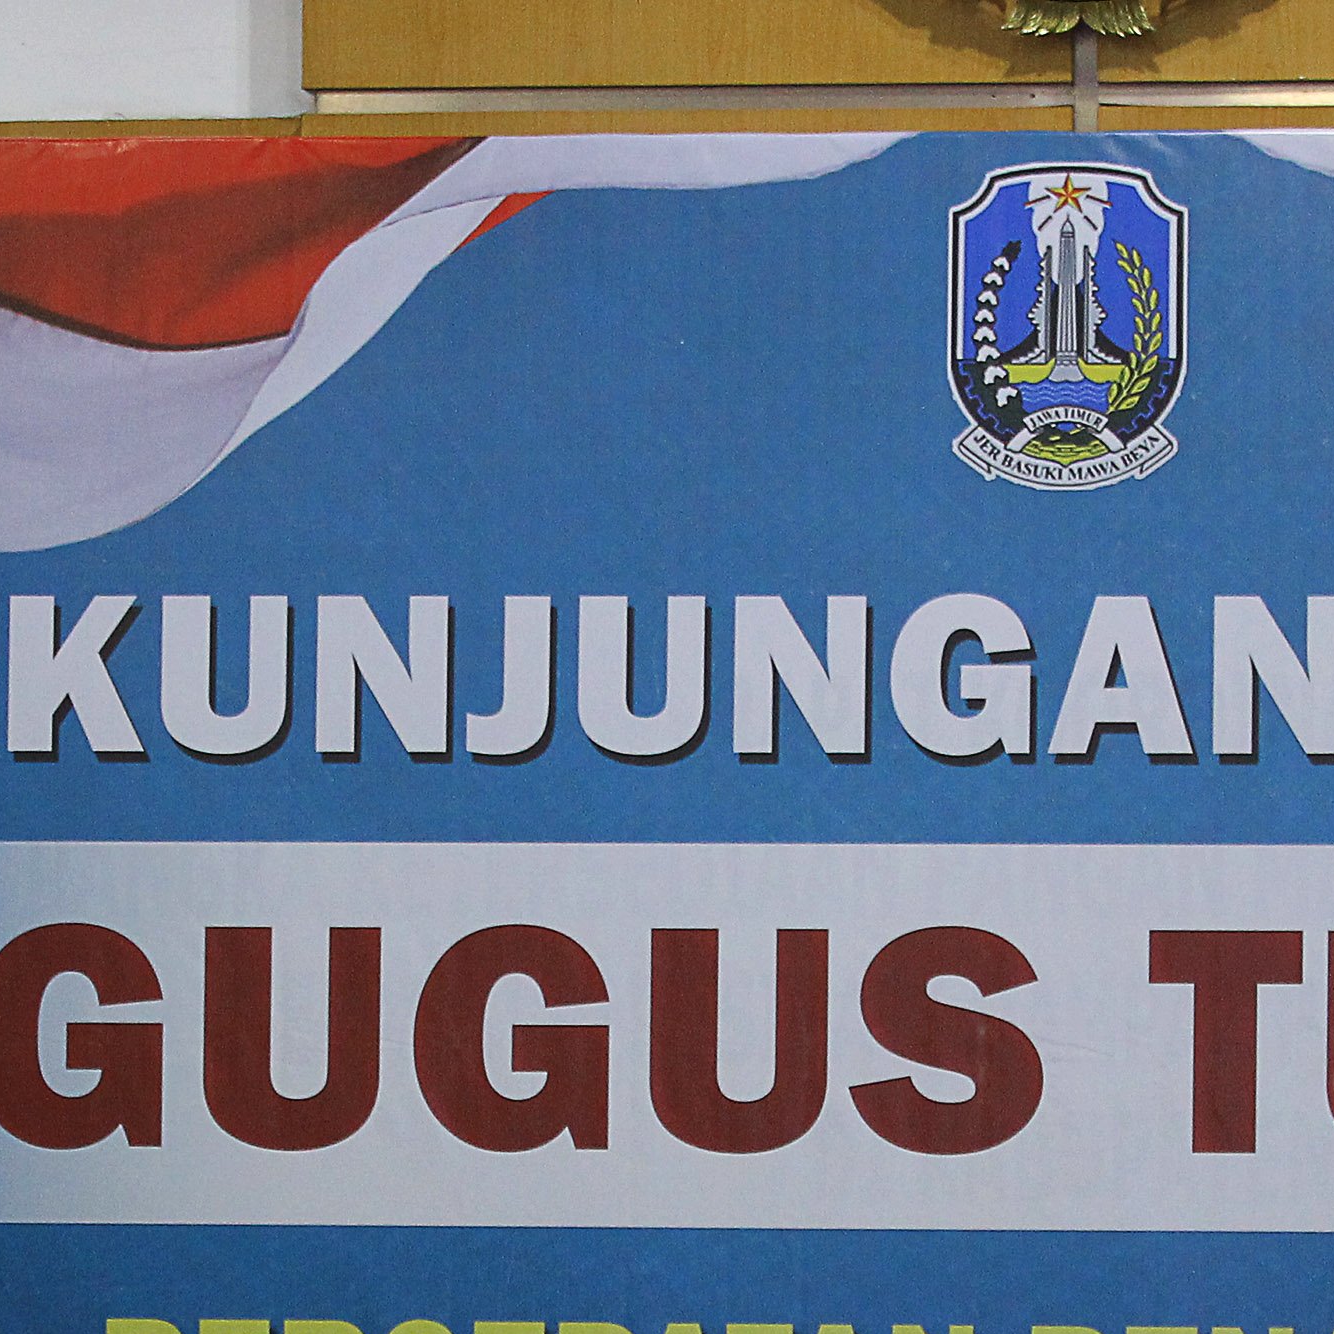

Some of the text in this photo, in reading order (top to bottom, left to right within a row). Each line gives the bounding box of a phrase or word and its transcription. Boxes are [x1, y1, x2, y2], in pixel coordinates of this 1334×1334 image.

[1030, 408, 1103, 428] JAWA TIMUR
[974, 434, 1160, 481] JER BASUKI MAWA BEYA
